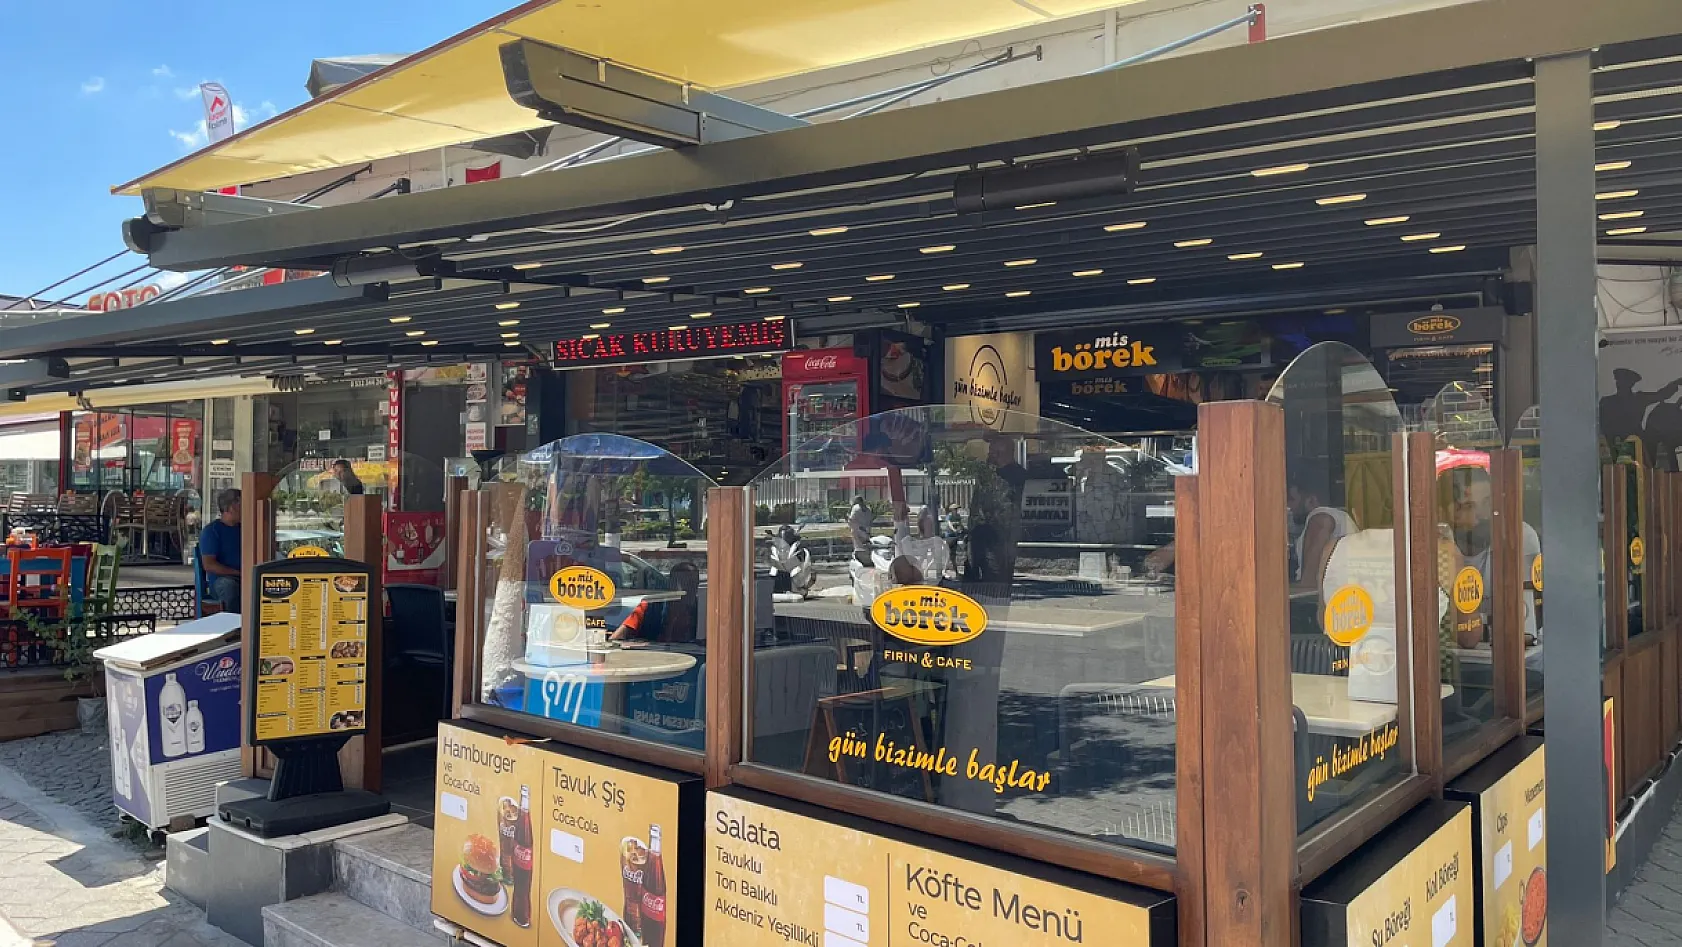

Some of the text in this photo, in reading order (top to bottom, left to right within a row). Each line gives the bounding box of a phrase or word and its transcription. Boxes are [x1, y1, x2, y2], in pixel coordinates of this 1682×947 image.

[1413, 319, 1454, 331] börek
[1095, 331, 1128, 348] mis
[1051, 341, 1157, 371] börek
[1071, 380, 1128, 395] börek
[557, 577, 606, 600] börek
[577, 571, 594, 583] mis
[920, 592, 947, 608] mis
[586, 617, 606, 628] CAFE
[884, 600, 972, 633] börek
[1331, 599, 1368, 633] börek
[884, 650, 972, 671] FIRIN & CAFE
[443, 737, 517, 774] Hamburger
[444, 761, 453, 773] ve
[828, 731, 867, 763] gün
[874, 732, 958, 777] bizimle
[966, 747, 1051, 794] başlar
[1307, 755, 1329, 803] gün
[1332, 736, 1368, 778] bizimle
[443, 773, 481, 796] Coca-Cola
[552, 766, 626, 813] Tavuk Şiş
[552, 794, 565, 807] ve
[552, 808, 599, 835] Coca-Cola
[716, 810, 782, 851] Salata
[716, 845, 762, 875] Tavuklu
[715, 870, 778, 907] Ton Balıklı
[856, 894, 865, 904] TL
[906, 863, 1083, 944] Köfte Menü
[908, 901, 928, 920] ve
[715, 897, 819, 947] Akdeniz Yeşillikli
[857, 923, 866, 933] TL
[1384, 896, 1411, 943] Böreği
